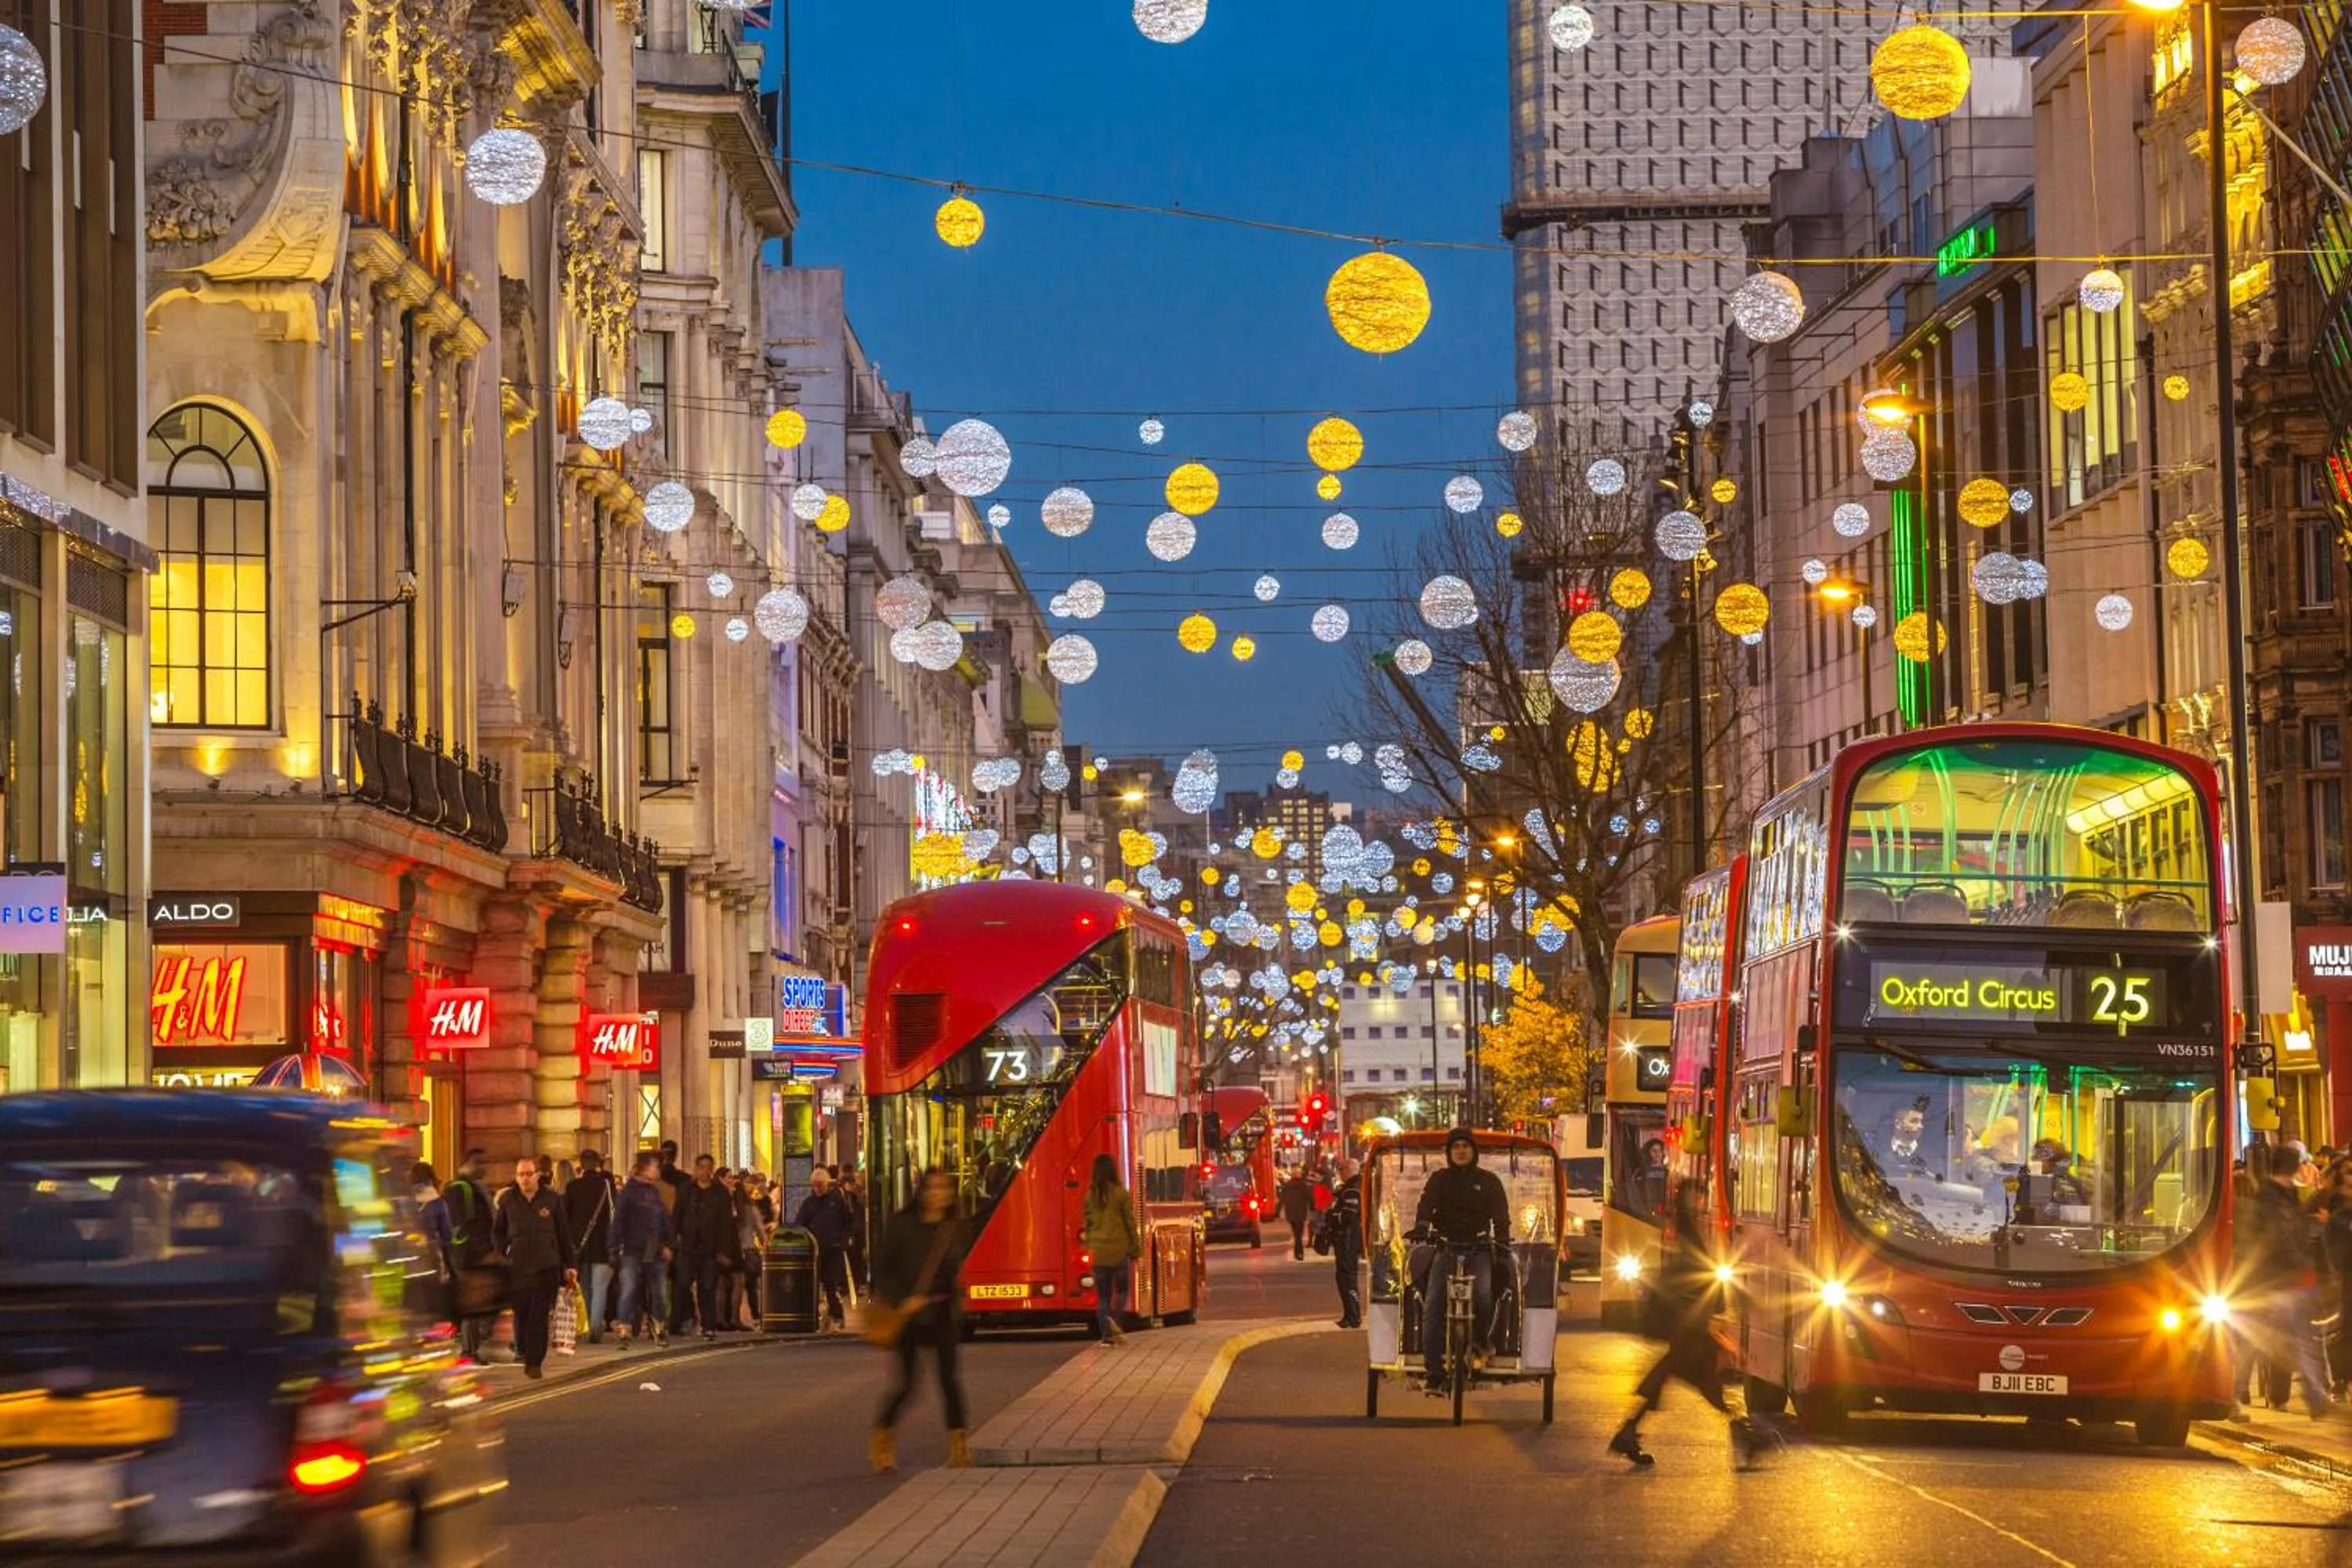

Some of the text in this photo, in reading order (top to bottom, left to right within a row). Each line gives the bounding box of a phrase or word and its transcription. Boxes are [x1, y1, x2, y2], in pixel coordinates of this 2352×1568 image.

[154, 903, 233, 920] ALDO
[152, 956, 246, 1043] H&M
[783, 977, 826, 1008] SPORTS
[1882, 978, 2056, 1010] Oxford Circus
[2091, 976, 2151, 1022] 25
[430, 1000, 483, 1036] H&M
[784, 1010, 814, 1033] DIRECT
[592, 1023, 637, 1054] H&M
[710, 1040, 742, 1048] Dune
[2158, 1044, 2214, 1057] VN36151
[985, 1051, 1026, 1081] 73
[1992, 1375, 2055, 1392] BJ11 EBC
